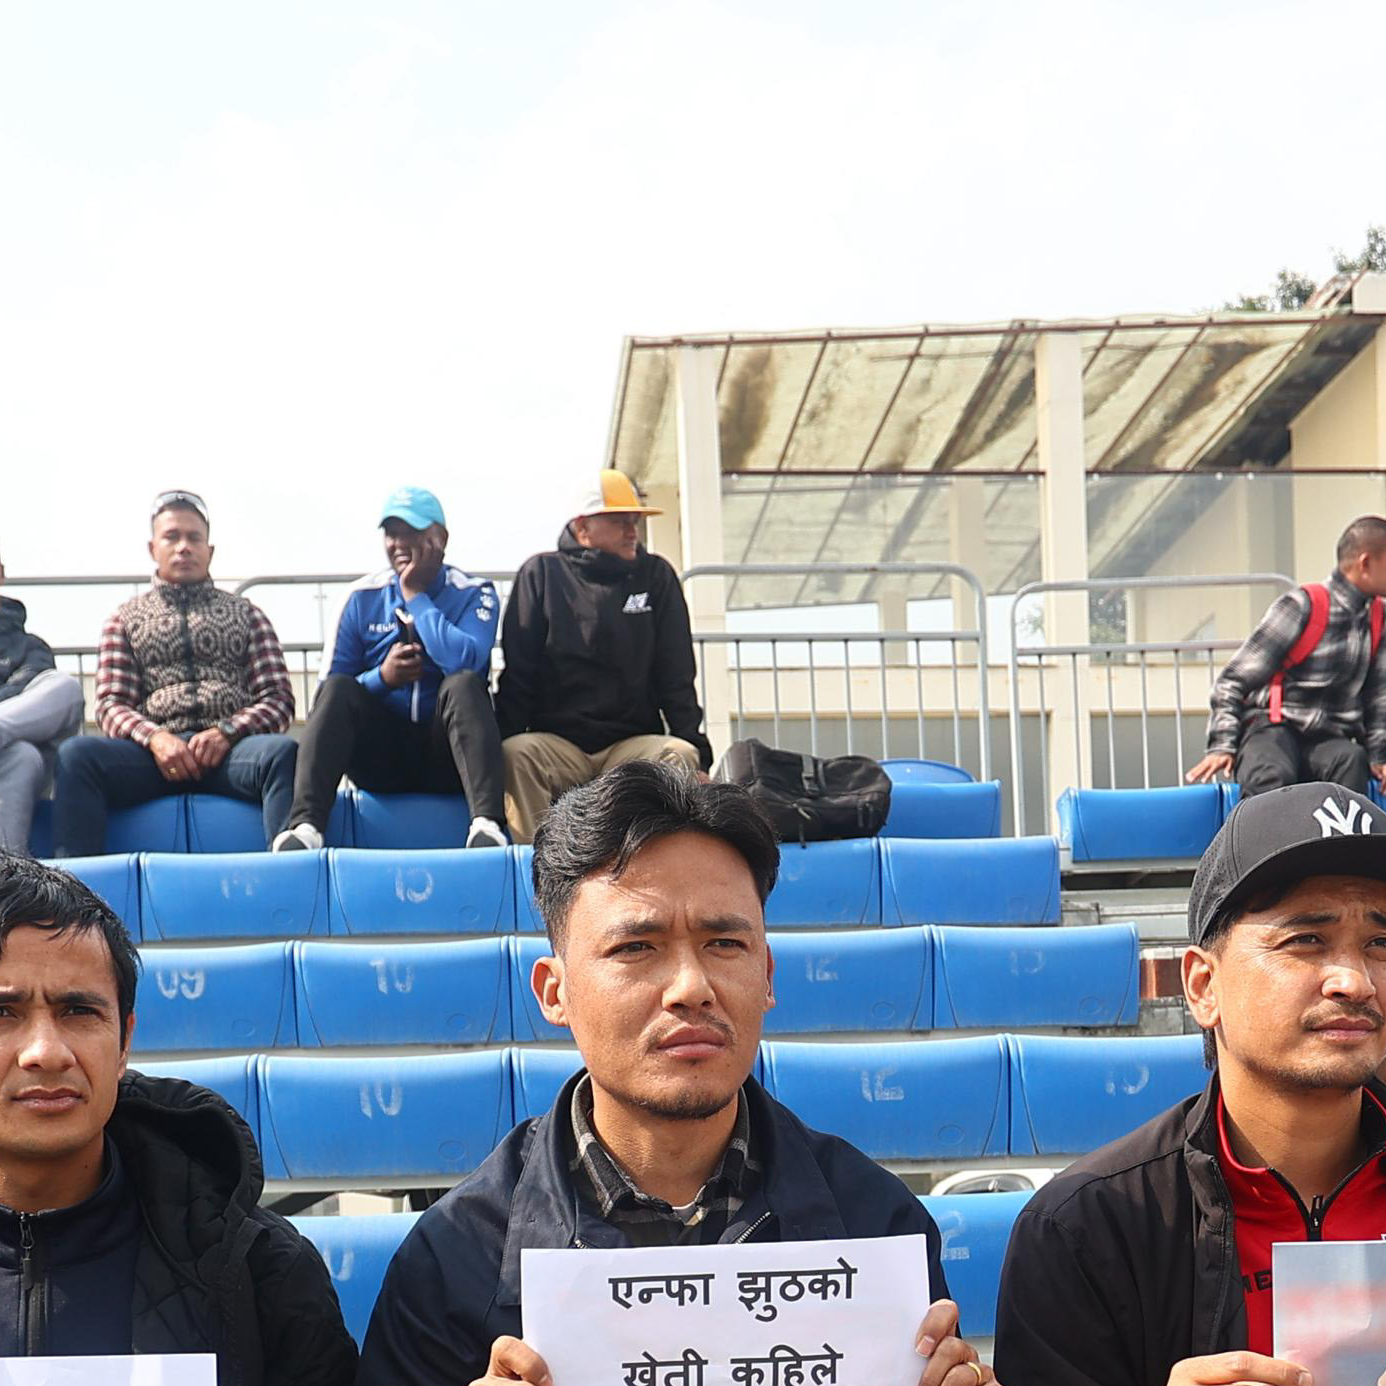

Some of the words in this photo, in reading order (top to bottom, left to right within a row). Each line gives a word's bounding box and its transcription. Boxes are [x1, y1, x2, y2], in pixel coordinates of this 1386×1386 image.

[156, 967, 206, 1001] 09
[608, 1274, 715, 1309] एन्फा
[737, 1257, 857, 1322] झुठको
